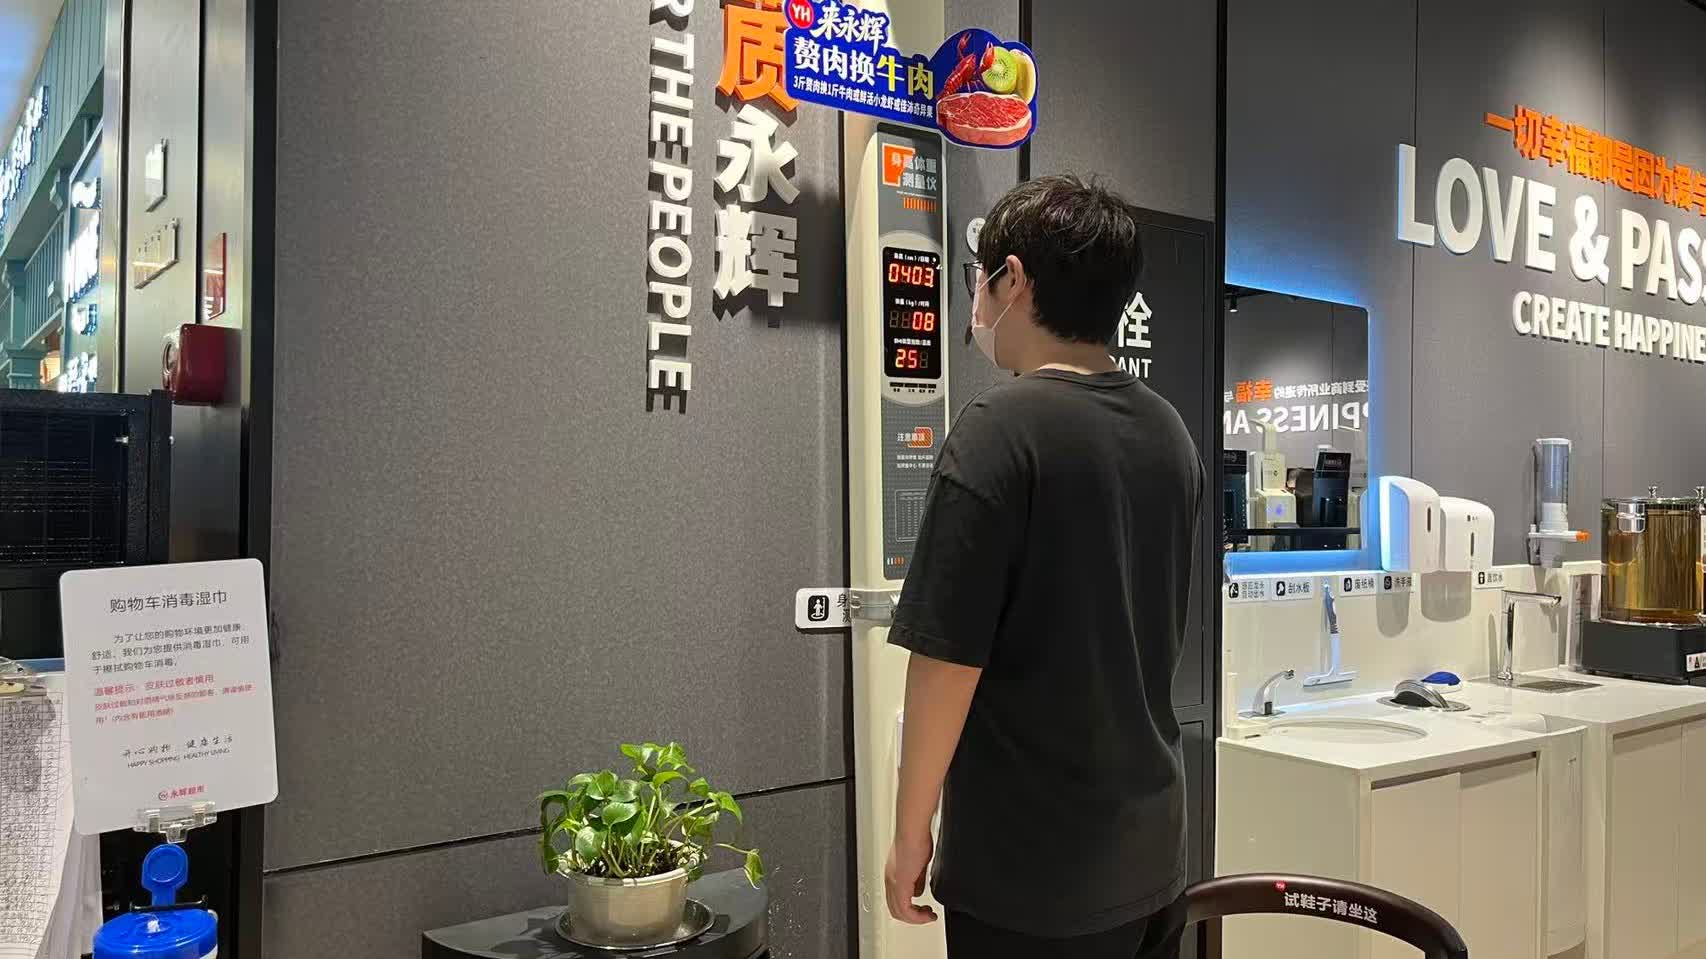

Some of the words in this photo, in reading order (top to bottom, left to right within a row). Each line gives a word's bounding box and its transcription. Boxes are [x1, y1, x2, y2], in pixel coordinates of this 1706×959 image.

[791, 4, 811, 22] YH
[809, 1, 887, 57] 来永辉
[650, 33, 694, 148] THE
[793, 36, 934, 101] 赘肉换牛肉
[714, 0, 800, 308] 质永辉
[902, 172, 937, 191] 测量仪
[1397, 143, 1557, 273] LOVE
[1569, 194, 1610, 284] &
[1620, 208, 1706, 306] PAS
[648, 159, 693, 392] PEOPLE
[1512, 290, 1611, 349] CREATE
[1108, 355, 1152, 379] ANT
[110, 590, 228, 614] 购物车消毒湿巾
[127, 758, 148, 769] HAPPY
[148, 755, 180, 766] SHOPPING
[183, 749, 209, 760] HEALTHY
[169, 785, 205, 799] 永辉超市
[1284, 891, 1378, 925] 试鞋子请坐这
